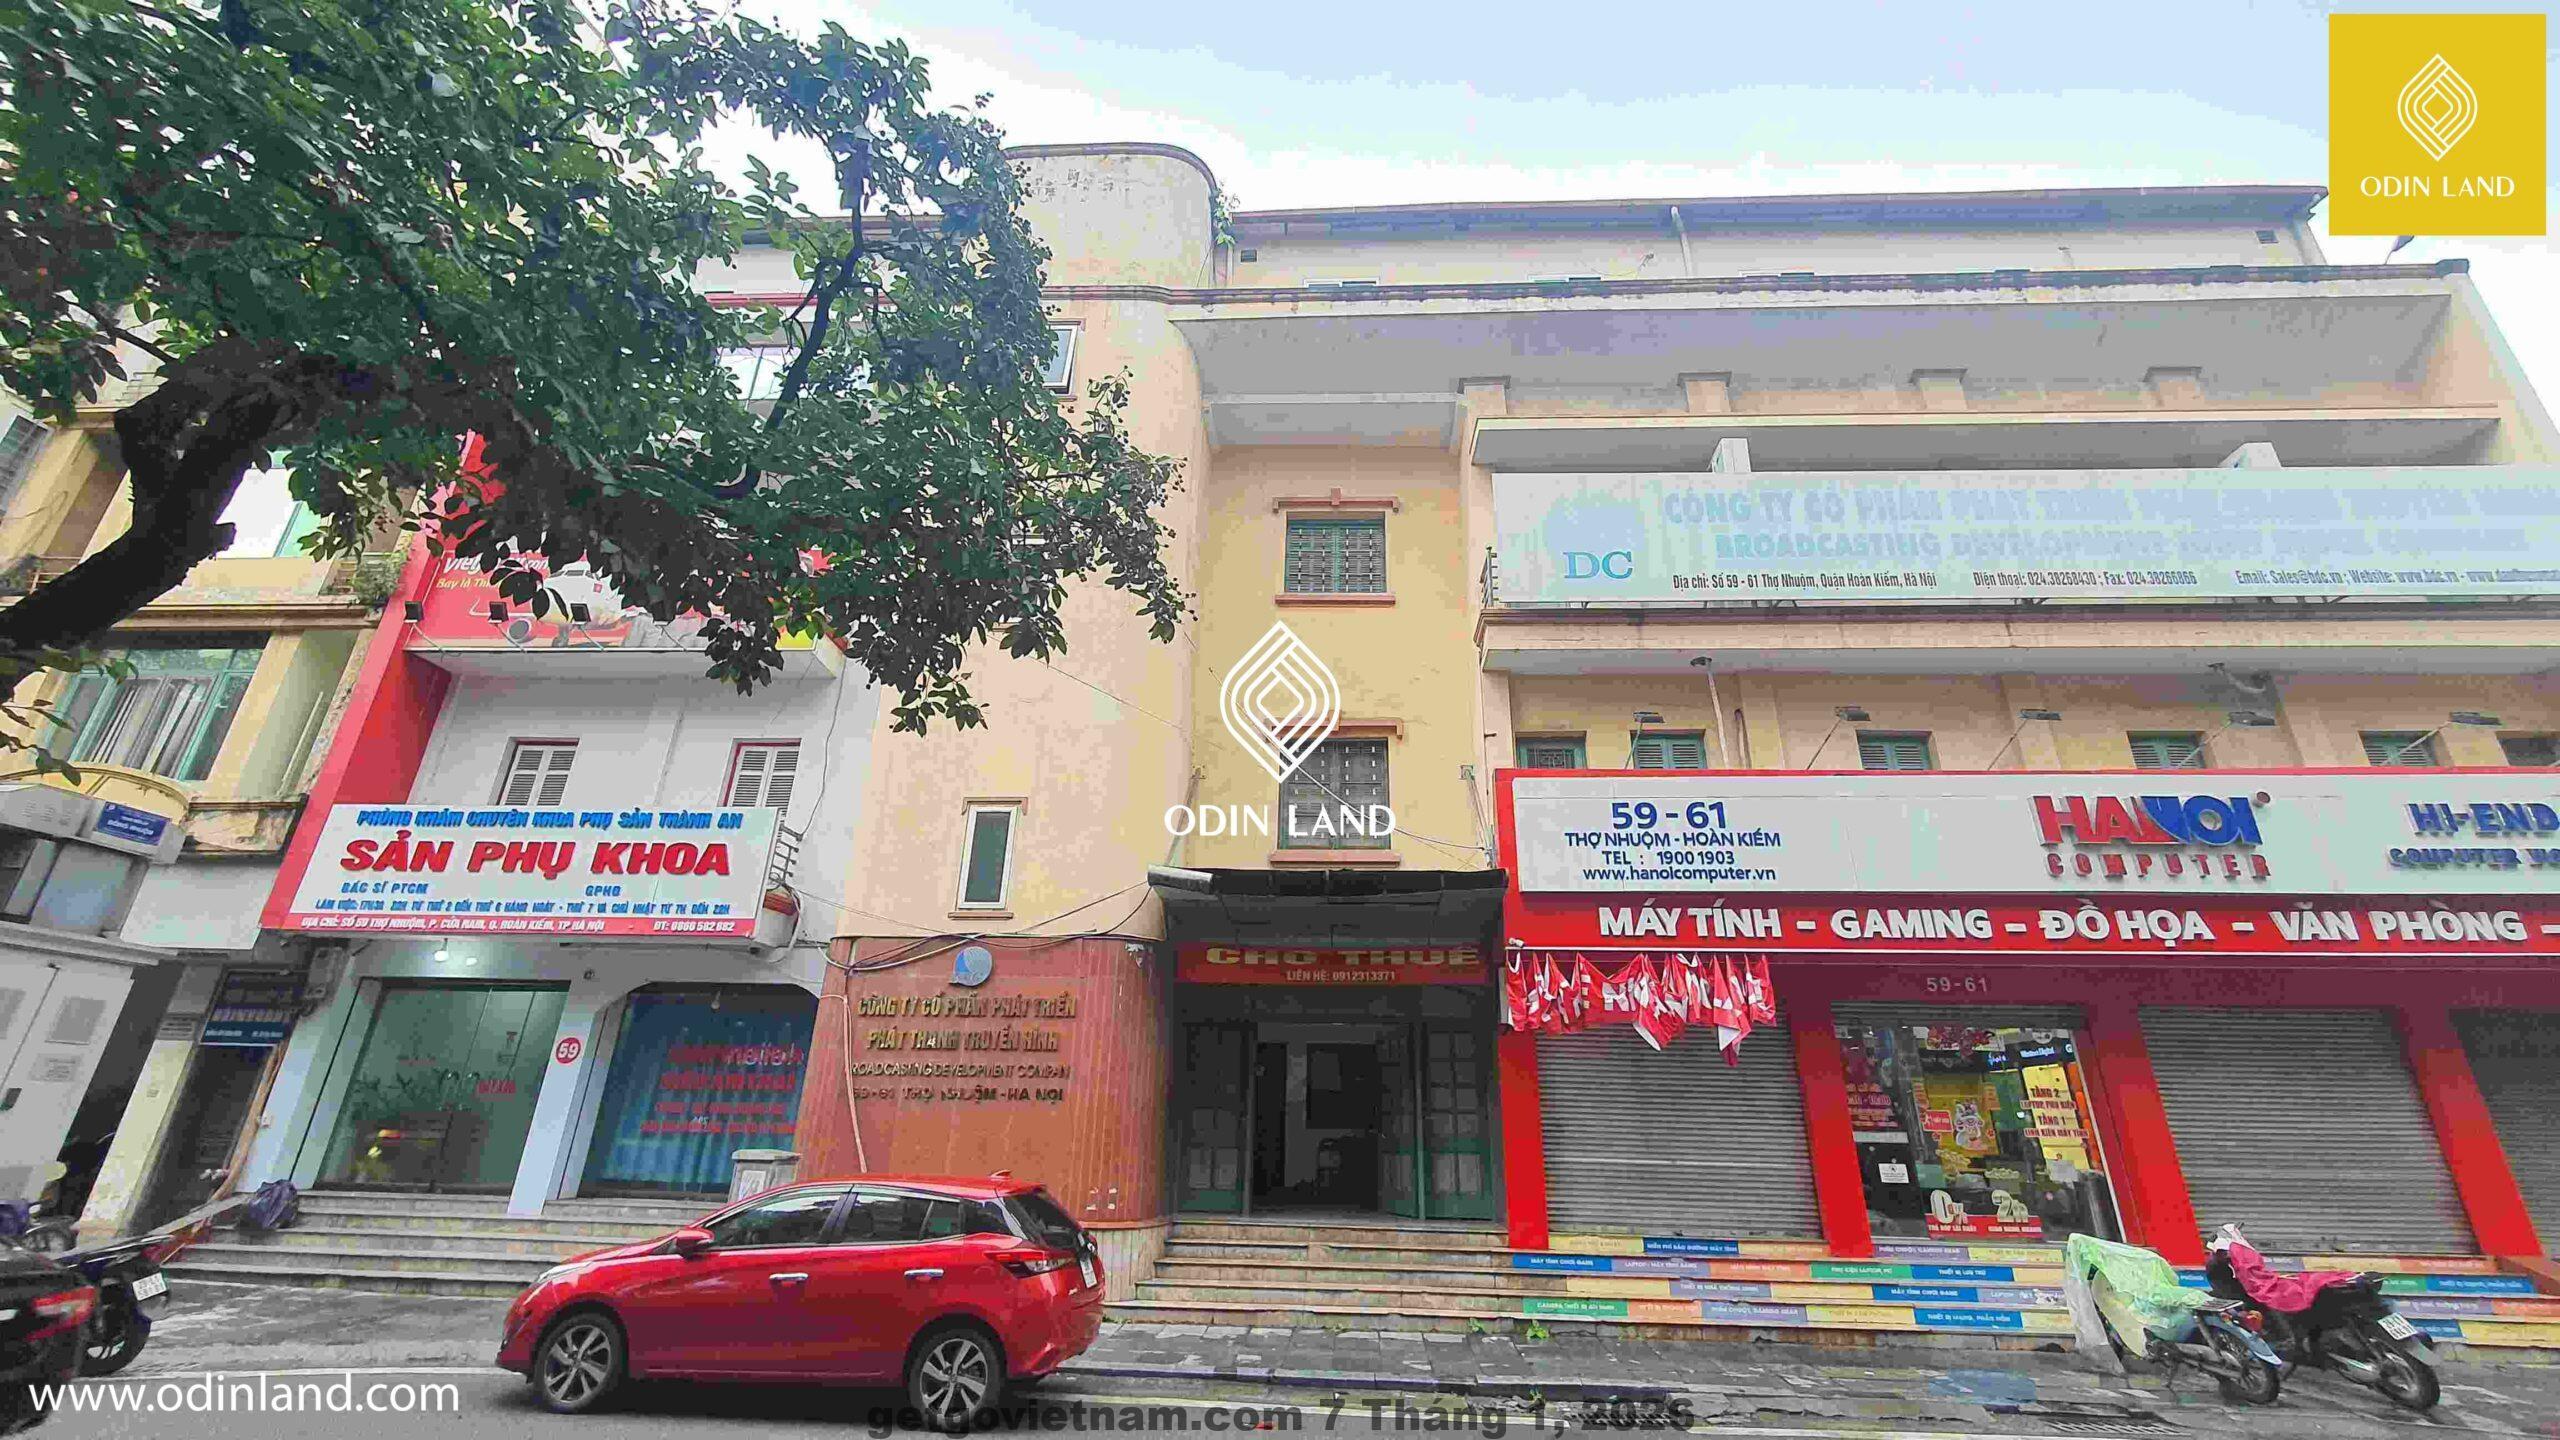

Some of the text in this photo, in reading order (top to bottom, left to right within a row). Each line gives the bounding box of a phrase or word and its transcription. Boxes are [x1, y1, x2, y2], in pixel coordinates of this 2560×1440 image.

[1726, 574, 1739, 588] 59
[1747, 573, 1759, 588] 61
[1762, 573, 1779, 591] Thợ
[1820, 573, 1845, 592] Quận
[1847, 573, 1872, 588] Hoàn
[1904, 572, 1918, 587] Hà
[1920, 572, 1937, 590] Nội
[2104, 572, 2126, 586] Fax:
[579, 812, 613, 831] PHỤ
[618, 807, 653, 829] SẢN
[717, 812, 744, 830] AN
[1611, 802, 1657, 830] 59
[1686, 801, 1726, 830] 61
[2030, 796, 2263, 846] HANOI
[1564, 832, 1601, 849] THỢ
[1605, 831, 1670, 850] NHUỘM
[1683, 828, 1734, 847] HOÀN
[340, 830, 730, 880] SẢN PHỤ KHOA
[1602, 851, 1632, 865] TEL
[2044, 853, 2271, 878] COMPUTER
[1599, 898, 1682, 937] MÁY
[1687, 897, 1782, 938] TÍNH
[1831, 908, 1993, 939] GAMING
[2038, 898, 2110, 940] ĐỒ
[2115, 909, 2214, 948] HỌA
[2270, 902, 2359, 942] VĂN
[2370, 901, 2527, 942] PHÒNG
[1206, 946, 1480, 965] CHO THUÊ
[1926, 976, 1988, 993] 59-61
[559, 1042, 578, 1059] 59
[2053, 1088, 2060, 1098] 2
